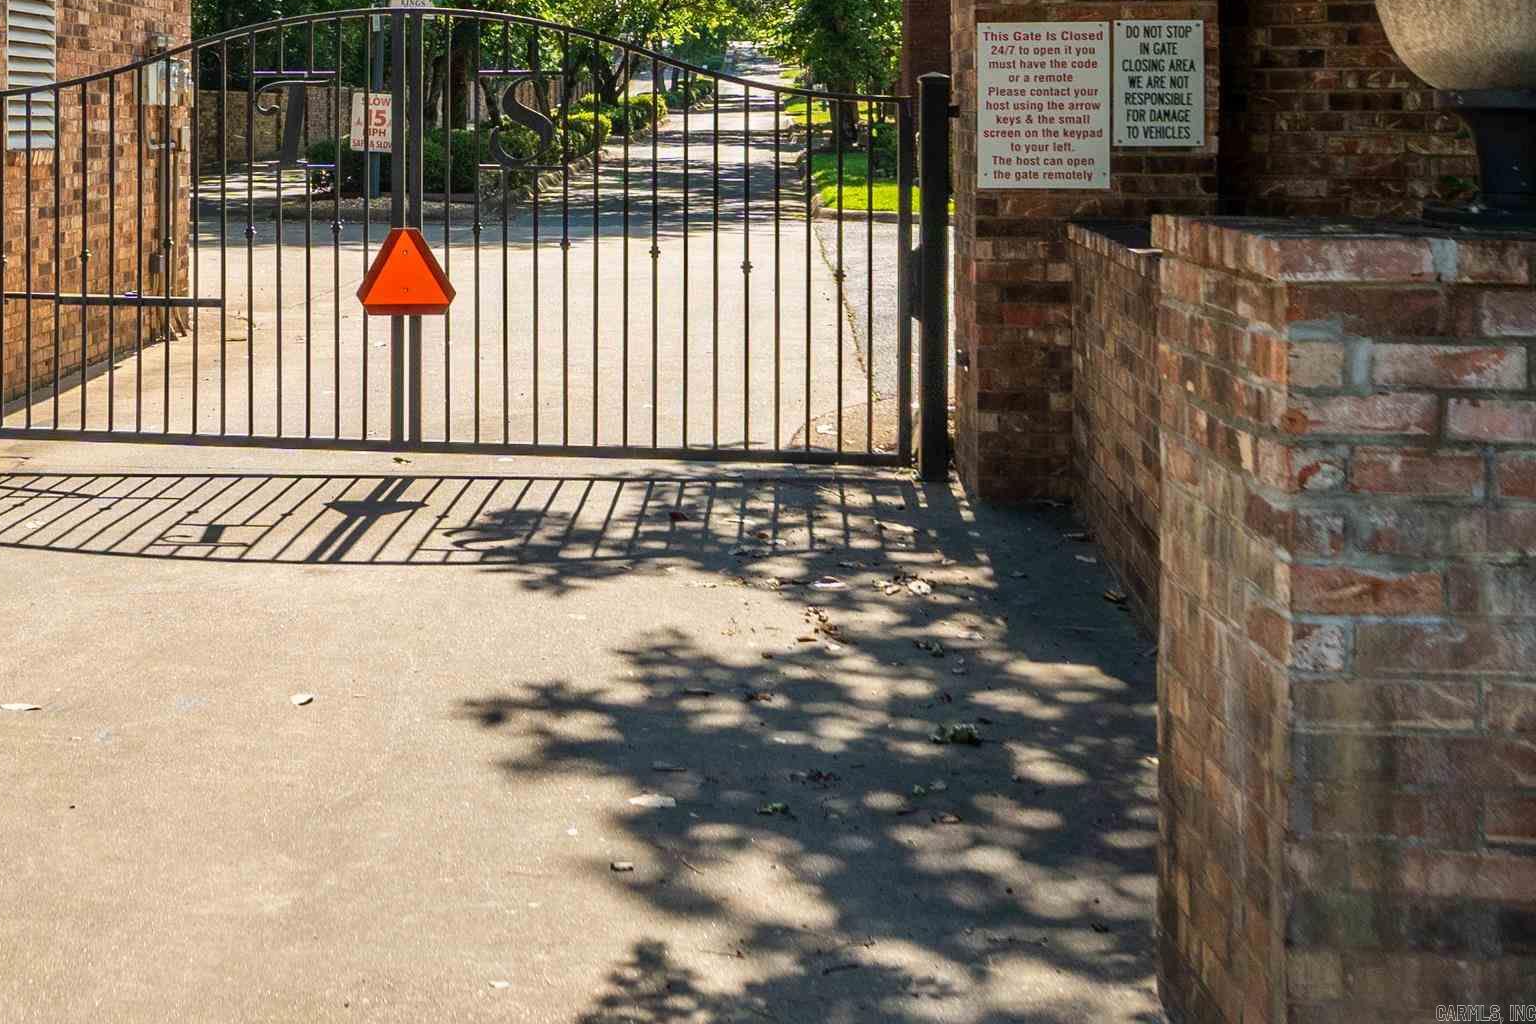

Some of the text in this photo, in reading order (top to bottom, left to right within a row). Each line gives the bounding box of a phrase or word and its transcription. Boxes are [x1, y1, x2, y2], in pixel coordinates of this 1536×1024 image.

[983, 30, 1104, 41] This Gate Is Closed
[1126, 25, 1192, 38] DO NOT STOP
[991, 45, 1096, 56] 24/7 to open it you
[1139, 42, 1178, 55] IN GATE
[988, 59, 1098, 69] must have the code
[1122, 59, 1196, 72] CLOSING AREA
[1008, 73, 1073, 83] or a remote
[1127, 76, 1189, 89] WE ARE NOT
[988, 87, 1099, 98] Please contact your
[1124, 93, 1193, 106] RESPONSIBLE
[985, 101, 1101, 112] host using the arrow
[996, 115, 1090, 126] keys & the small
[1126, 109, 1191, 122] FOR DAMAGE
[983, 128, 1103, 140] screen on the keypad
[1126, 126, 1191, 139] TO VEHICLES
[1010, 142, 1021, 152] to
[1024, 144, 1049, 153] your
[992, 156, 1095, 167] The host can open
[993, 170, 1093, 181] the gate remotely
